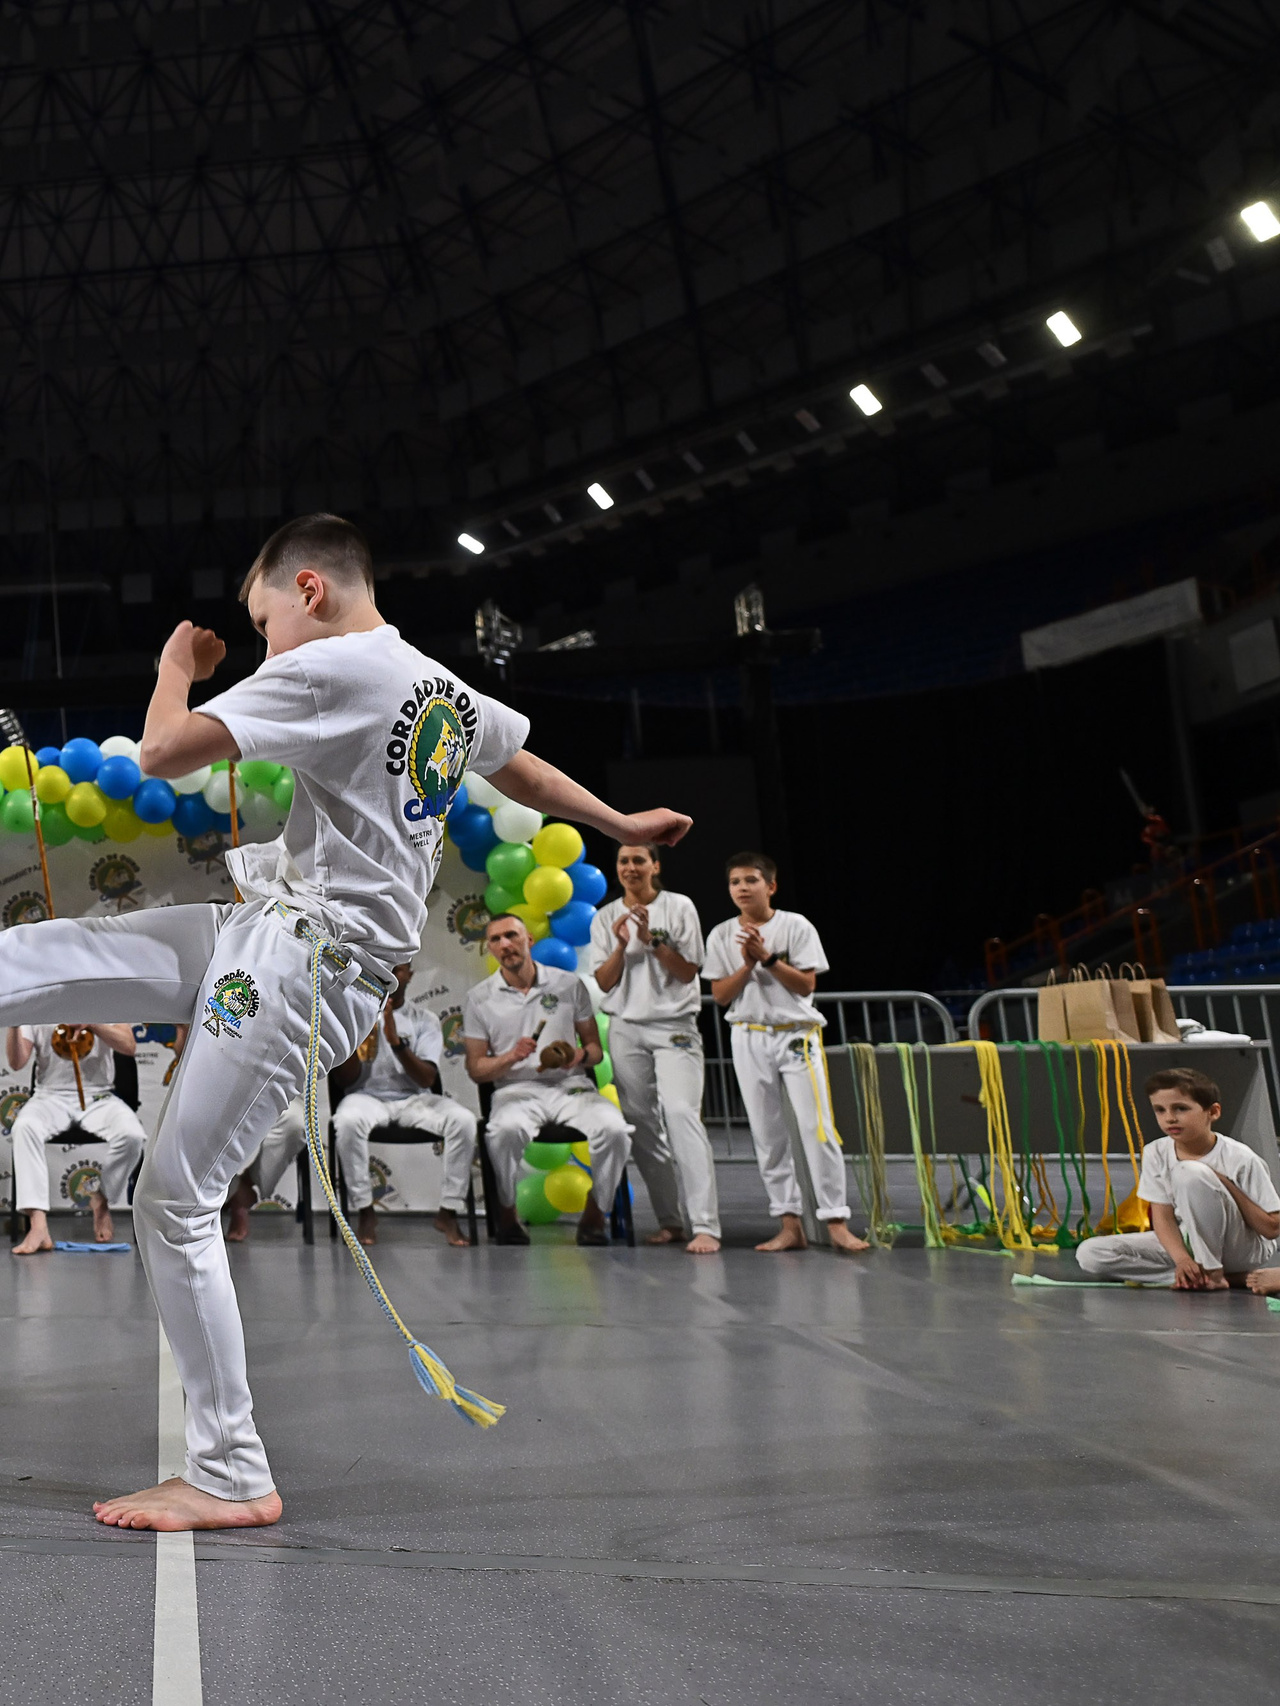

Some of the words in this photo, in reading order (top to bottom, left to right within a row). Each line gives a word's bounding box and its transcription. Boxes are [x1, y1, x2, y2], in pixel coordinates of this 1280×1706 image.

[385, 680, 434, 776] CORDÃO
[433, 676, 455, 699] DE
[409, 829, 433, 841] MESTRE
[413, 839, 430, 849] WELL
[214, 968, 245, 989] CORDÃO
[244, 974, 256, 988] DE
[207, 996, 242, 1030] CAPOEIRA
[247, 989, 260, 1018] OURO
